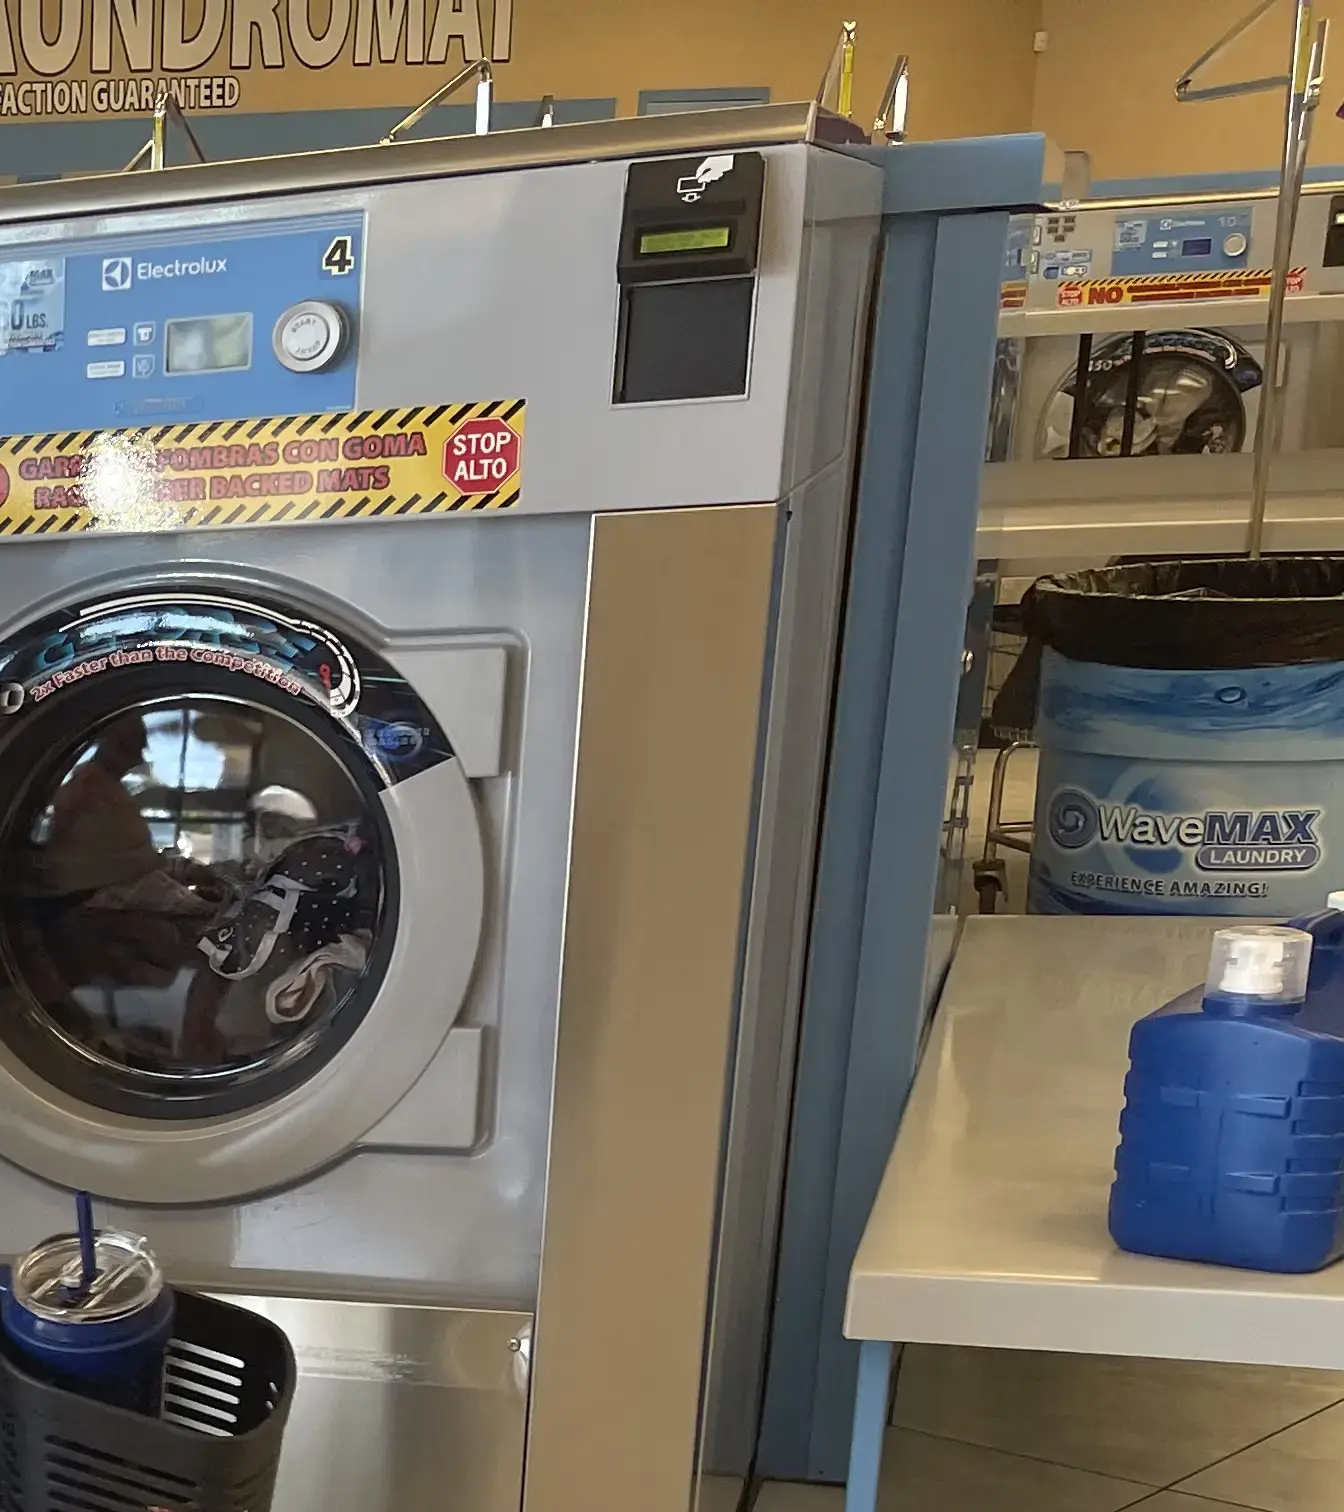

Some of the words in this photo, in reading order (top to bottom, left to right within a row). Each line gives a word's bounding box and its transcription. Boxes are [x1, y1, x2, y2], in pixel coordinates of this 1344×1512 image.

[92, 76, 241, 112] GUARANTEED
[136, 256, 228, 281] Electrolux
[322, 235, 354, 275] 4
[1088, 286, 1123, 304] NO
[282, 437, 339, 465] CON
[342, 431, 427, 460] GOMA
[452, 431, 511, 456] STOP
[210, 470, 313, 499] BACKED
[316, 465, 390, 493] MATS
[454, 458, 508, 482] ALTO
[29, 681, 55, 702] 2x
[52, 657, 109, 687] Faster
[109, 648, 154, 667] than
[155, 646, 188, 661] the
[1099, 806, 1321, 846] WaveMAX
[1210, 848, 1308, 865] LAUNDRY
[1071, 872, 1164, 896] EXPERIENCE
[1169, 880, 1269, 898] AMAZING!
